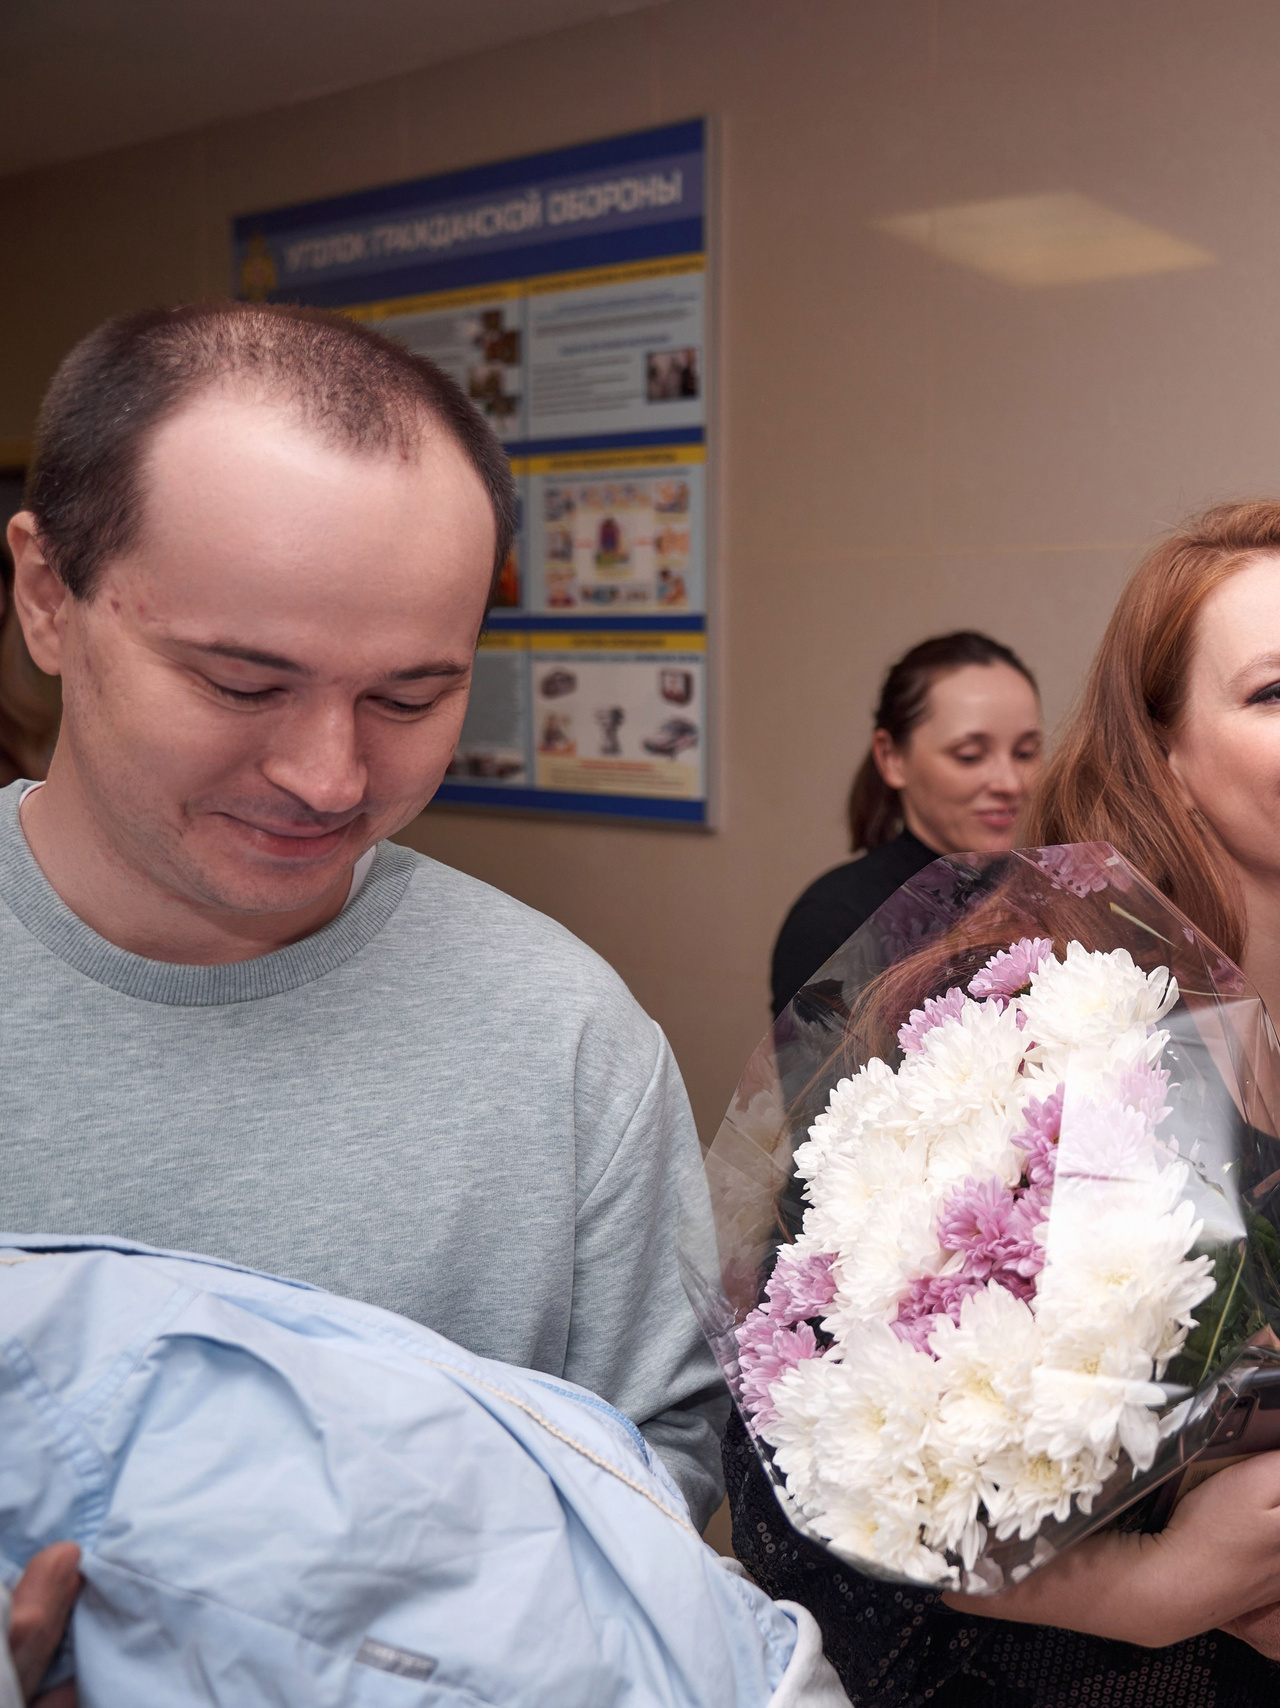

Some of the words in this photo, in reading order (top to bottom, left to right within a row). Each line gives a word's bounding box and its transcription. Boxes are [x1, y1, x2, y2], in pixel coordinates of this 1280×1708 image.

[284, 232, 366, 272] УГОЛОК
[371, 188, 542, 257] ГРАЖДАНСКОЙ
[548, 168, 683, 226] ОБОРОНЫ
